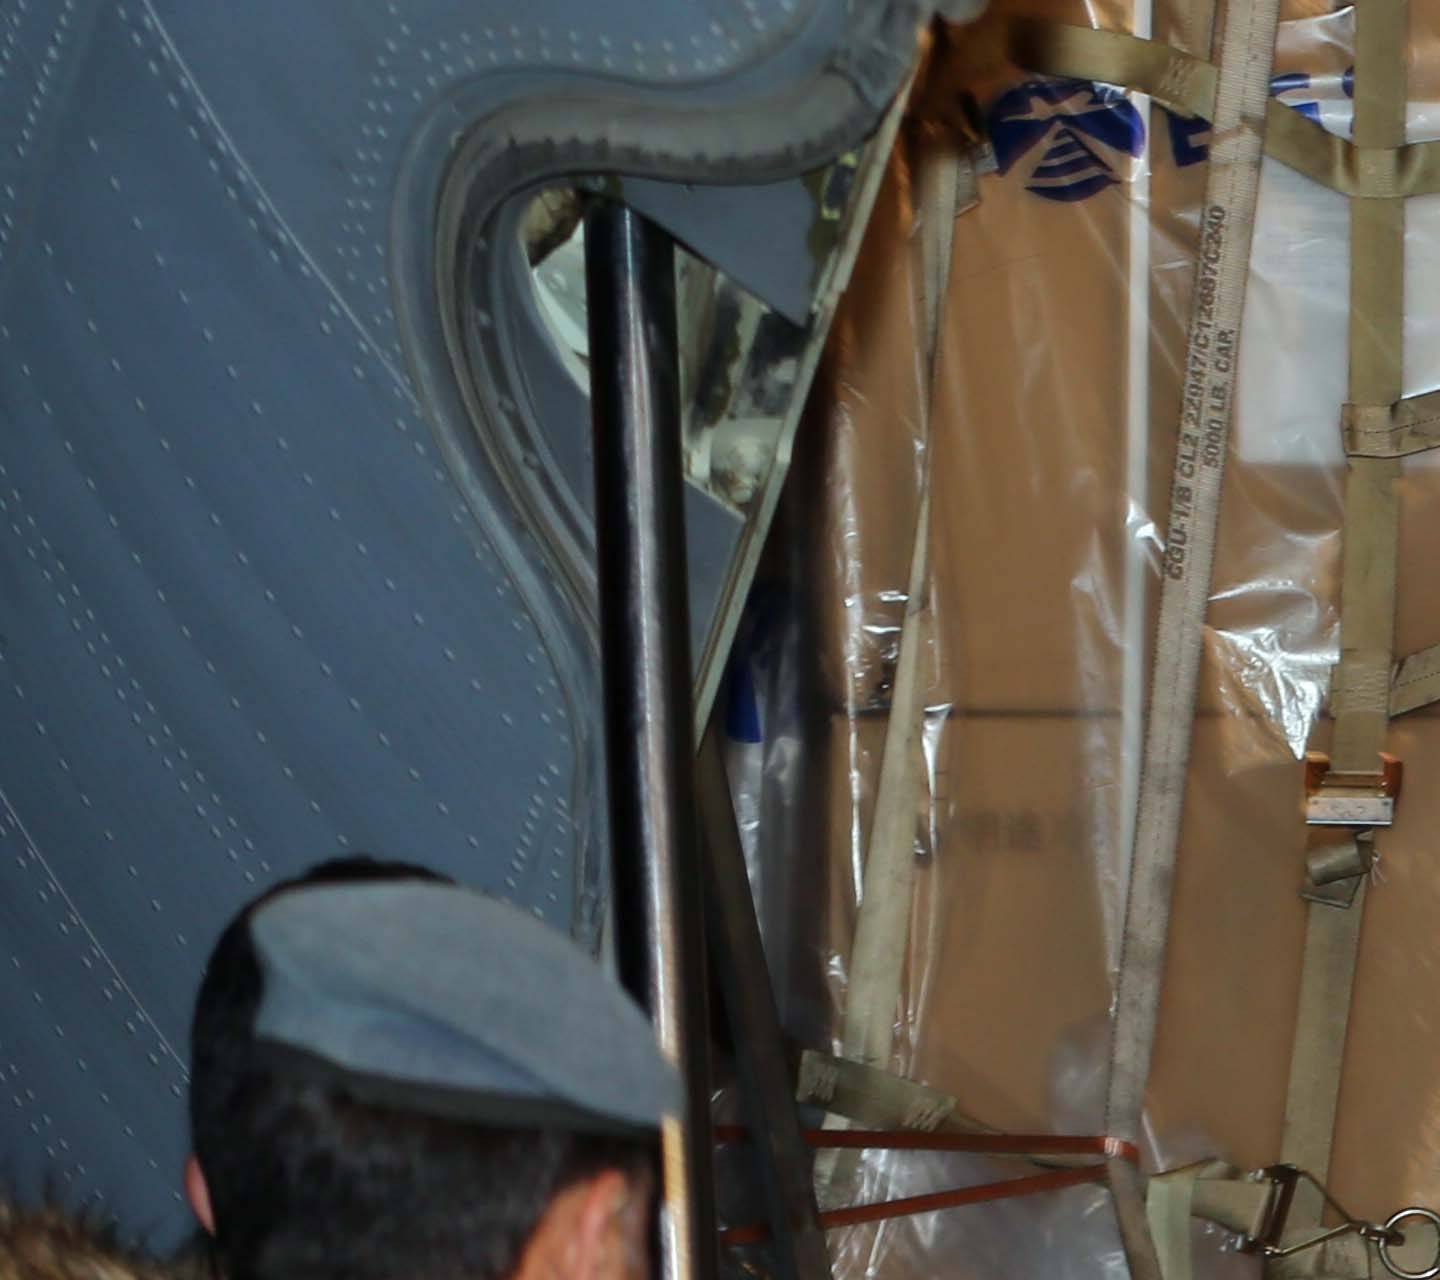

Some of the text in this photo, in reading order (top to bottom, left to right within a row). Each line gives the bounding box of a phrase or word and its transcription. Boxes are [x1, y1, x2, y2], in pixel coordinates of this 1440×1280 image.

[1201, 419, 1223, 468] 5000
[1164, 486, 1193, 581] CGU-1/B
[1180, 433, 1201, 479] CL2
